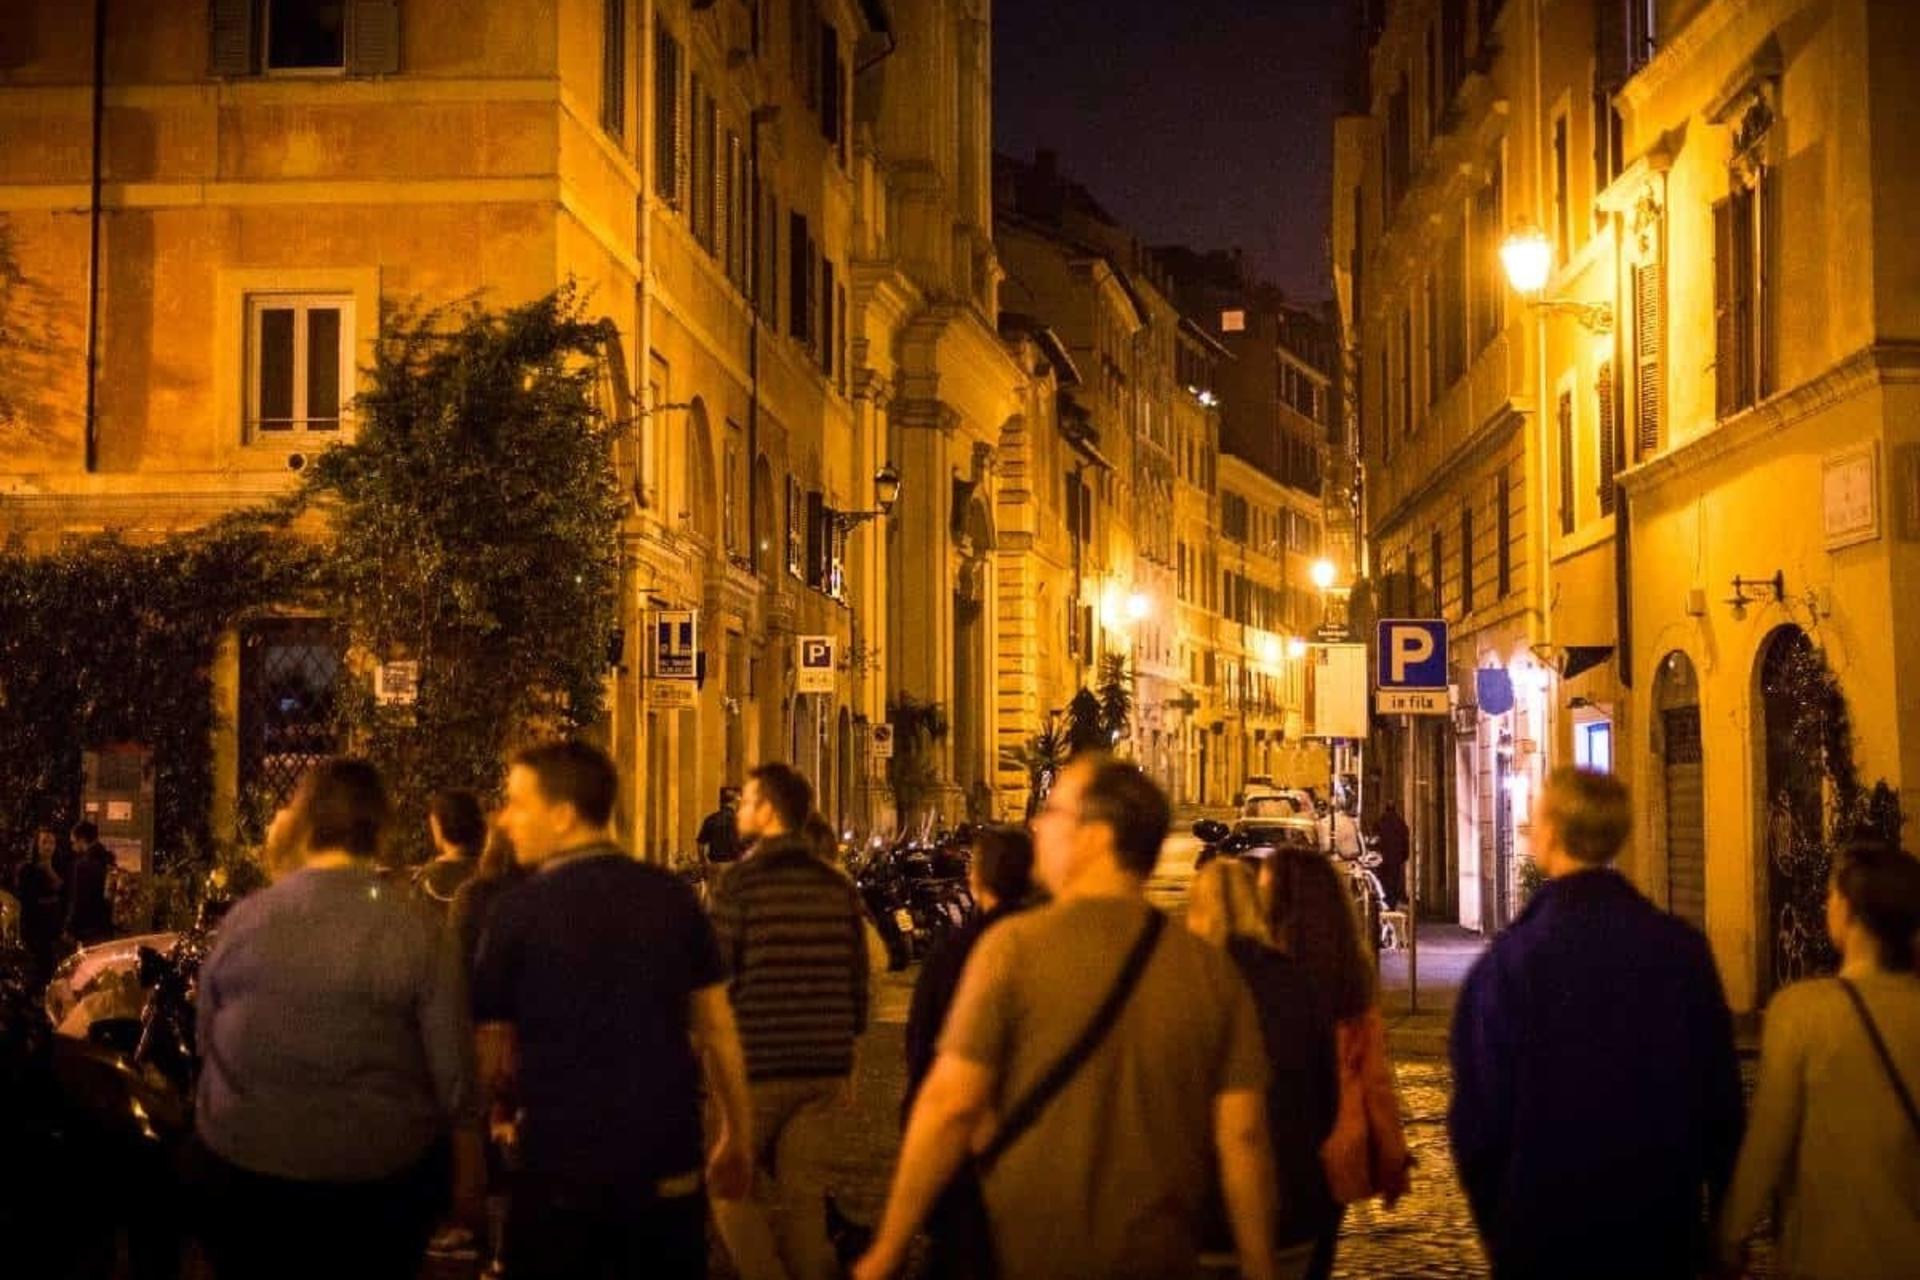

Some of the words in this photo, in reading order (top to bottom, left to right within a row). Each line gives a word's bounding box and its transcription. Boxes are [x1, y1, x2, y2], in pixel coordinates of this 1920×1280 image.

[661, 614, 690, 656] T
[809, 644, 825, 664] P
[1391, 626, 1434, 682] P
